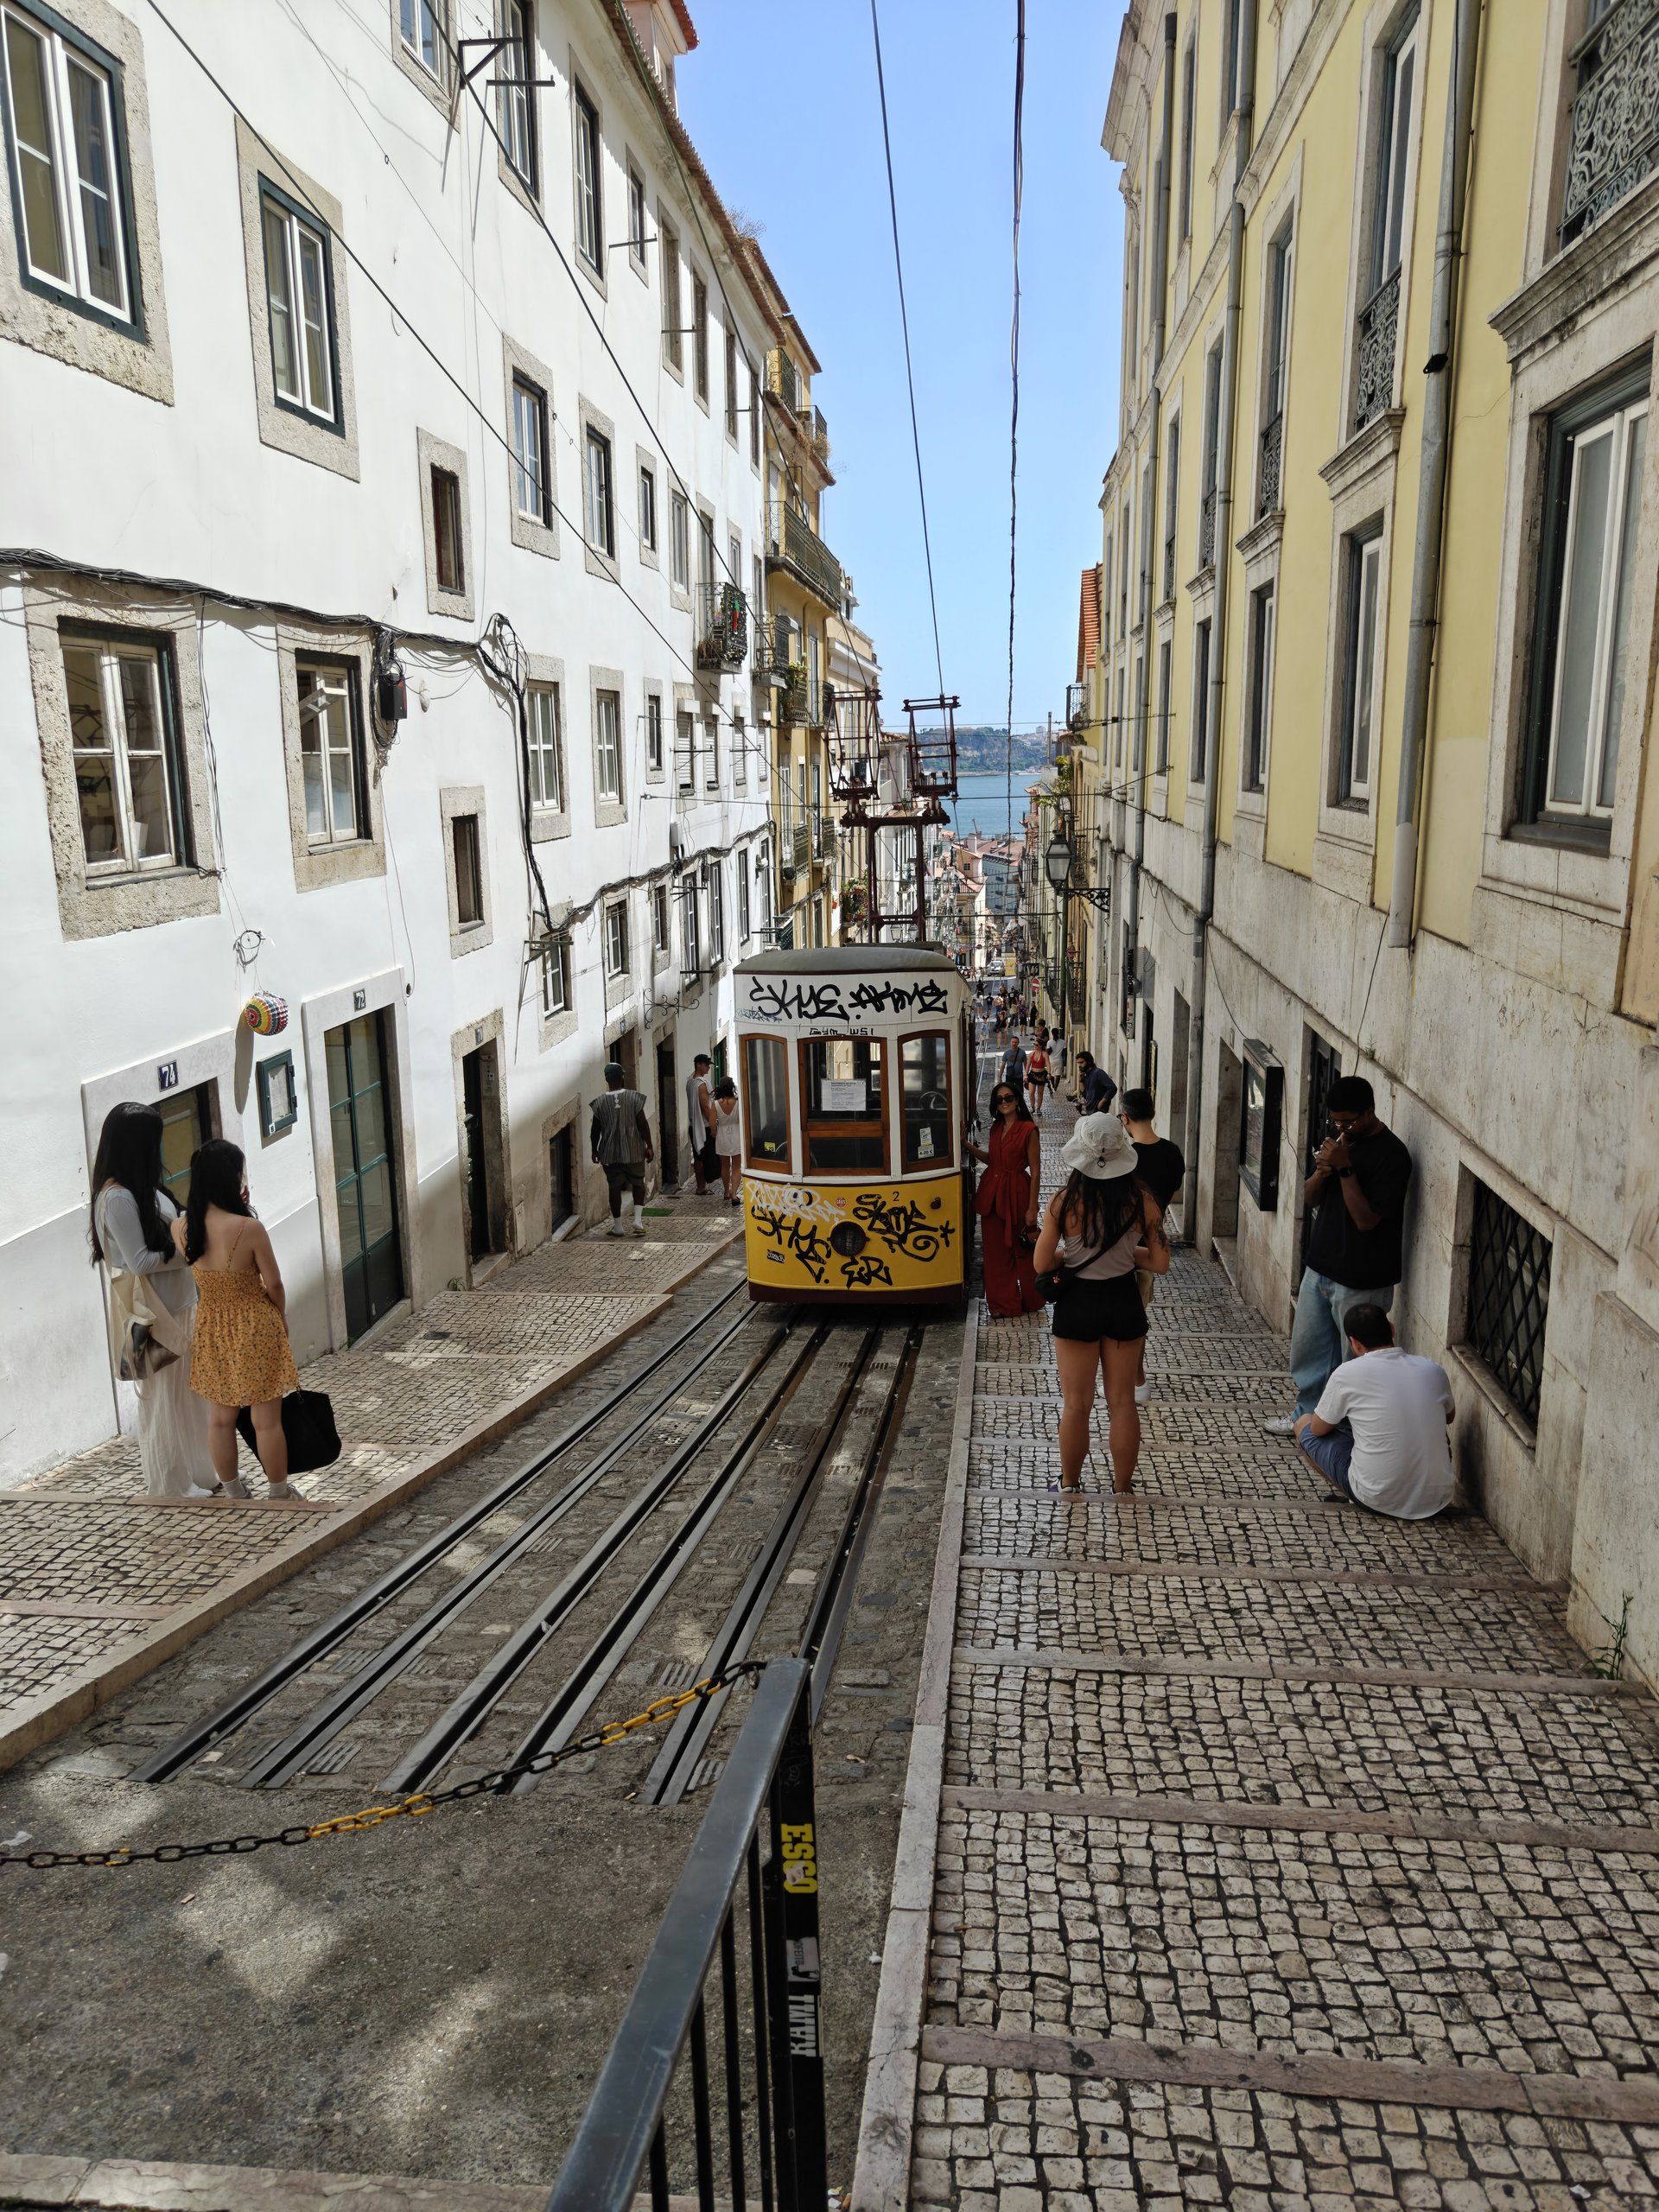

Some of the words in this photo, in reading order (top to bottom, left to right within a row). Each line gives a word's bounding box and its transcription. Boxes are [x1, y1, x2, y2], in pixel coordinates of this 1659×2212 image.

[355, 990, 365, 1009] 72
[162, 1063, 176, 1088] 74
[892, 1191, 899, 1202] 2
[780, 1823, 818, 1894] ESSO
[788, 1994, 817, 2057] KAMI
